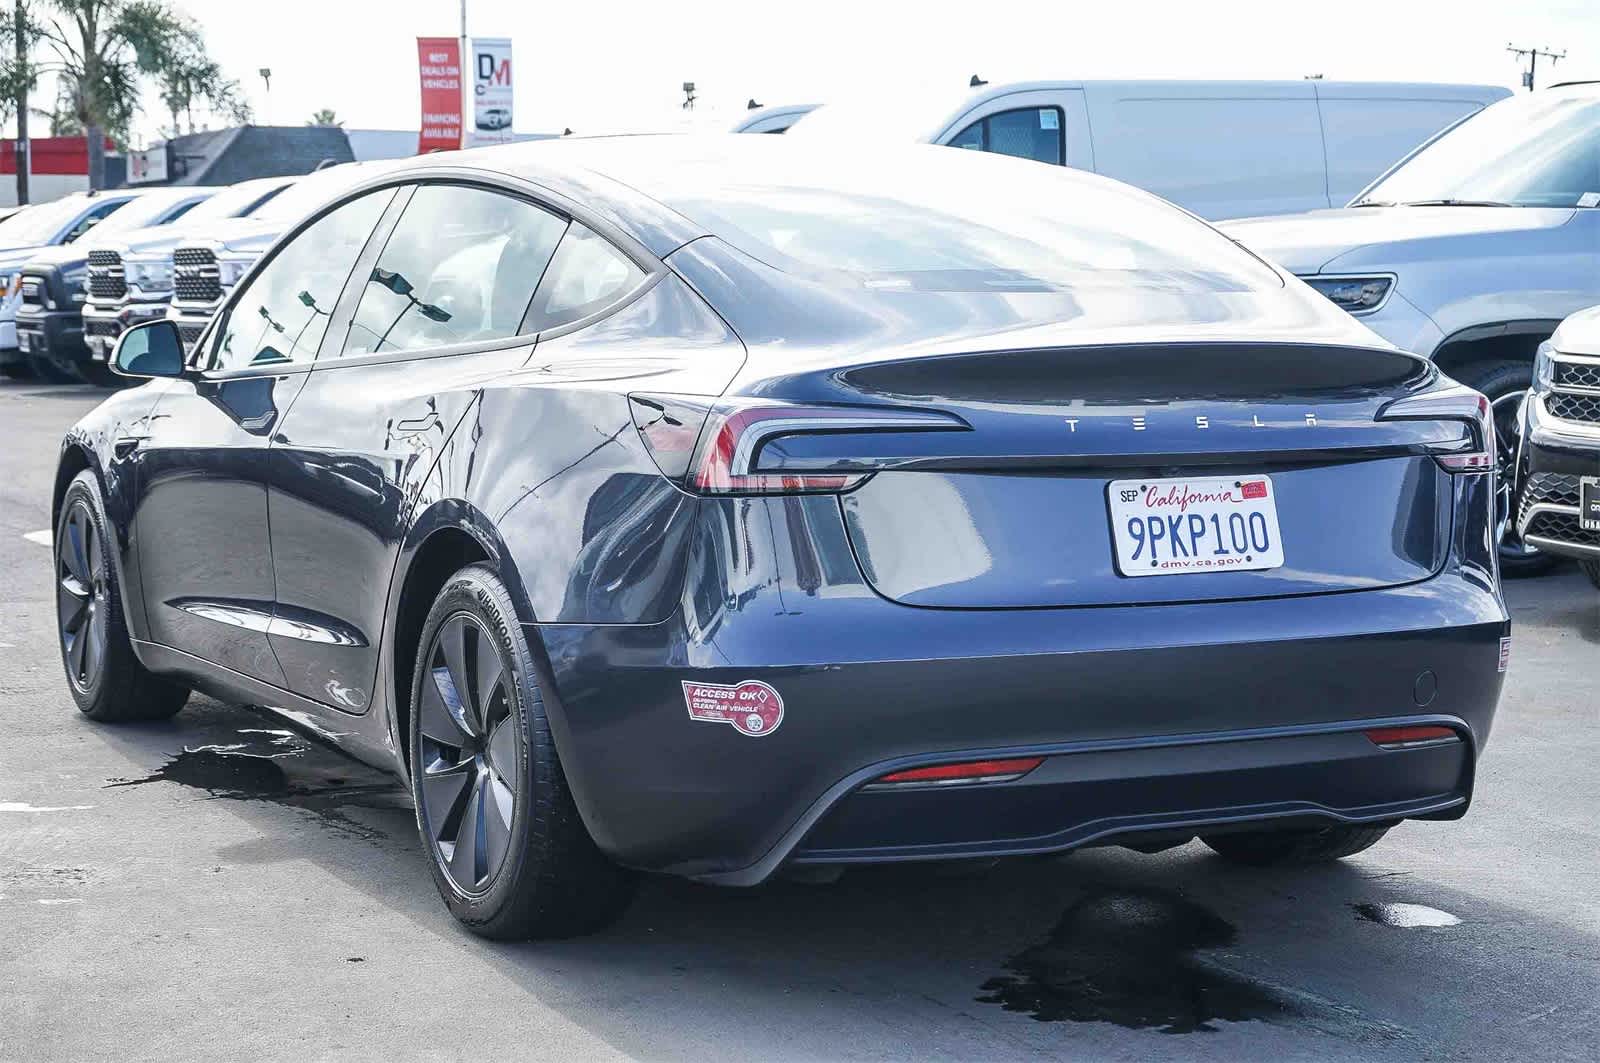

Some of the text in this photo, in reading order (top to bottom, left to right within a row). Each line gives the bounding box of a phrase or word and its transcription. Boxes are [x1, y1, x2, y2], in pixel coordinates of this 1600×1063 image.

[421, 66, 445, 76] DEALS
[423, 79, 459, 89] VEHICLES
[423, 113, 460, 125] FINANCING
[423, 127, 459, 139] AVAILABLE
[1065, 413, 1318, 432] TESLA
[1120, 490, 1139, 503] SEP
[1145, 484, 1243, 513] California
[1127, 511, 1270, 561] 9PKP100
[1160, 557, 1243, 569] dmv.ca.gov
[692, 688, 758, 700] ACCESS OK
[692, 702, 714, 710] CLEAN
[729, 705, 759, 713] VEHICLE
